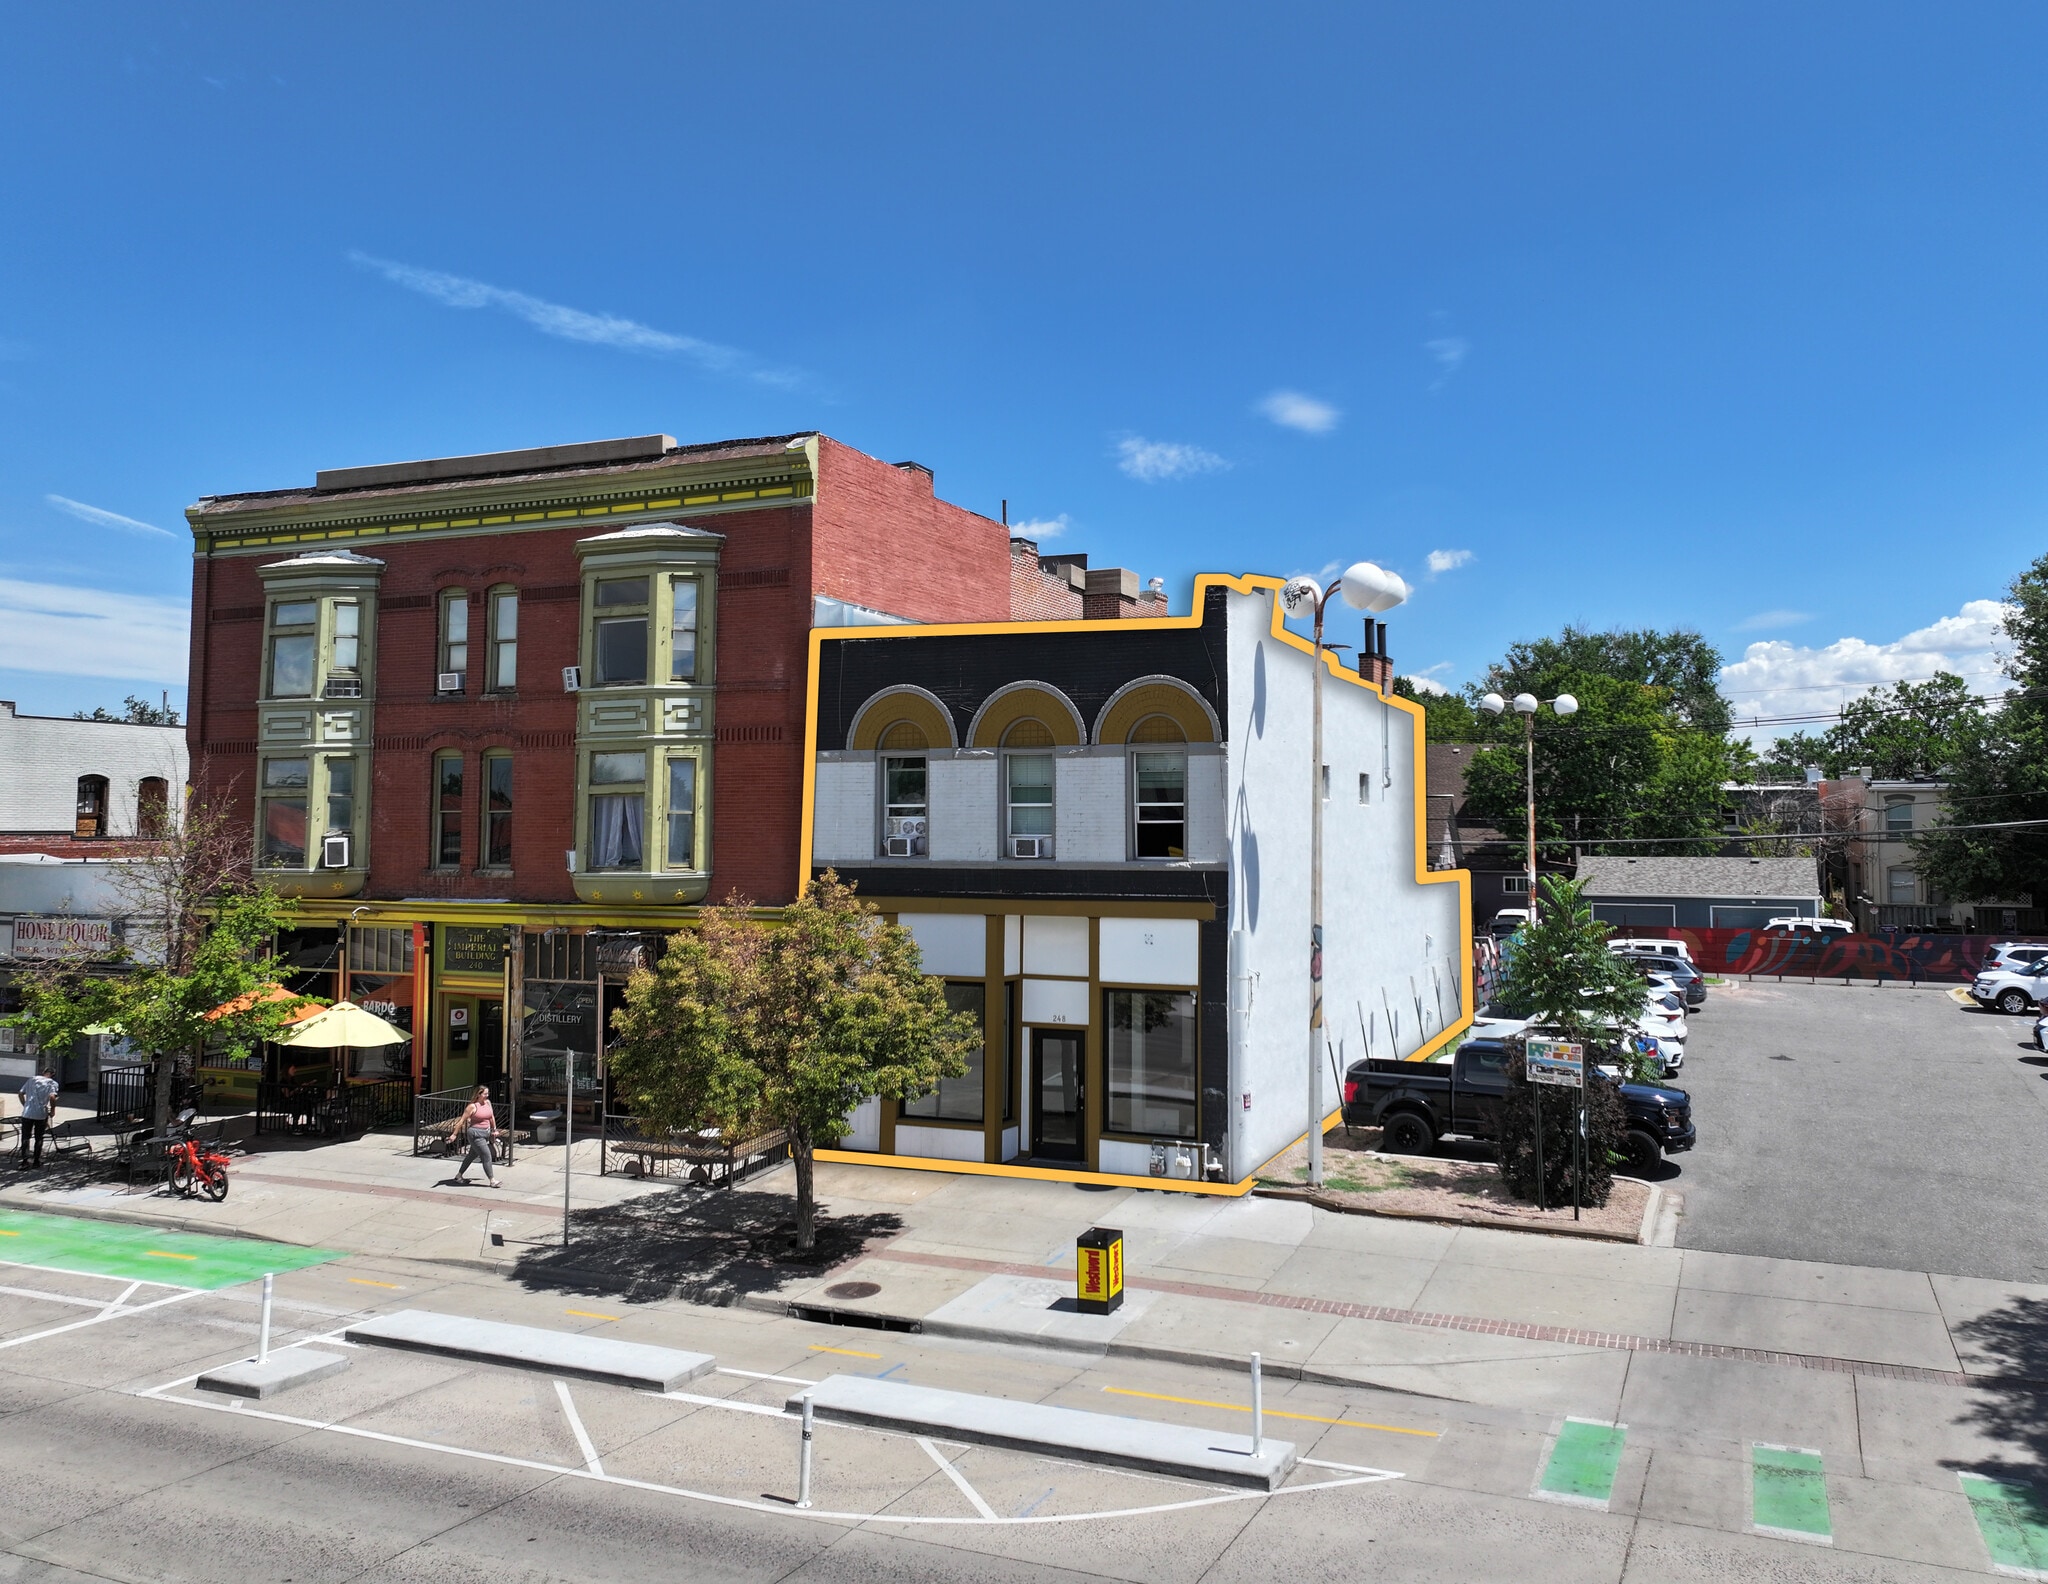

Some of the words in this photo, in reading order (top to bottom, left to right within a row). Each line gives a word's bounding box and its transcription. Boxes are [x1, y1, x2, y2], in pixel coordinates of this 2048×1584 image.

[17, 921, 54, 940] HOME
[59, 923, 109, 943] LIQUOR
[468, 934, 485, 943] THE
[453, 942, 497, 952] IMPERIAL
[455, 951, 496, 961] BUILDING
[469, 961, 484, 970] 240
[540, 1013, 582, 1024] DISTILLERY
[1052, 1014, 1066, 1023] 248
[1085, 1249, 1100, 1293] Westword
